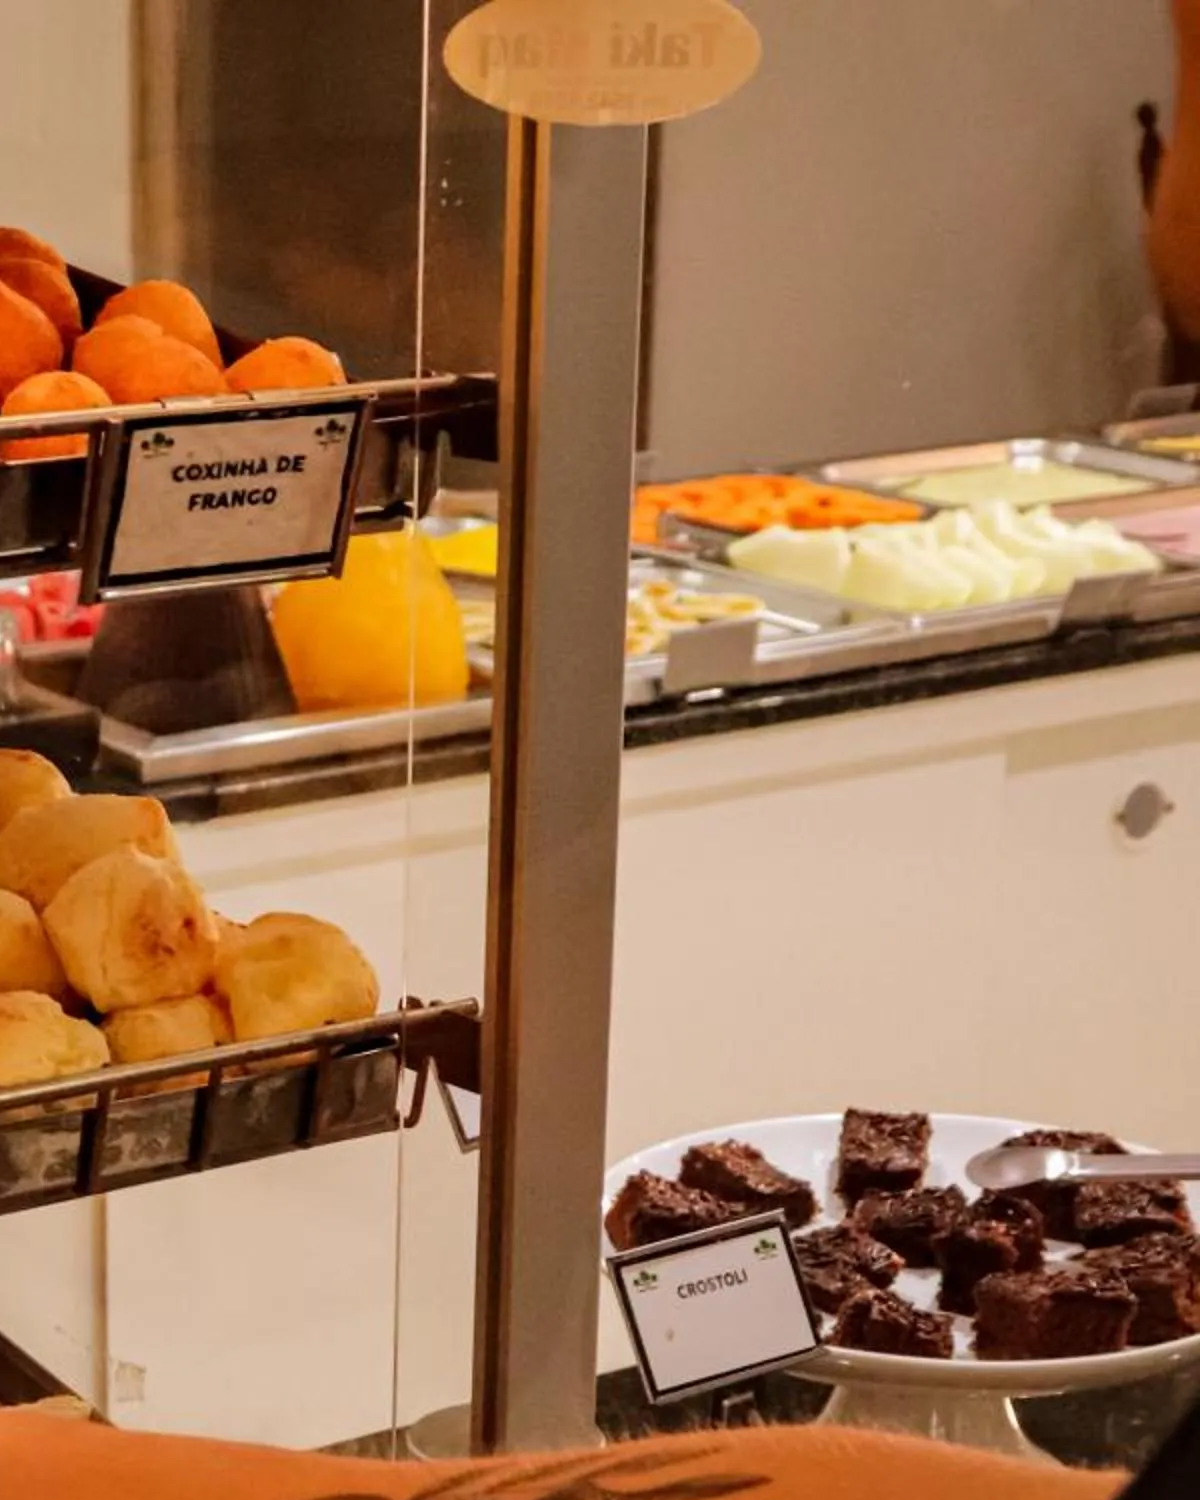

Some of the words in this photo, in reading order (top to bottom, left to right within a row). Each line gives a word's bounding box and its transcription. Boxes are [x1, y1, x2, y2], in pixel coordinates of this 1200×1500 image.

[171, 458, 268, 483] COXINHA
[275, 455, 306, 473] DE
[187, 487, 277, 512] FRANGO
[676, 1268, 749, 1300] CROSTOLI
